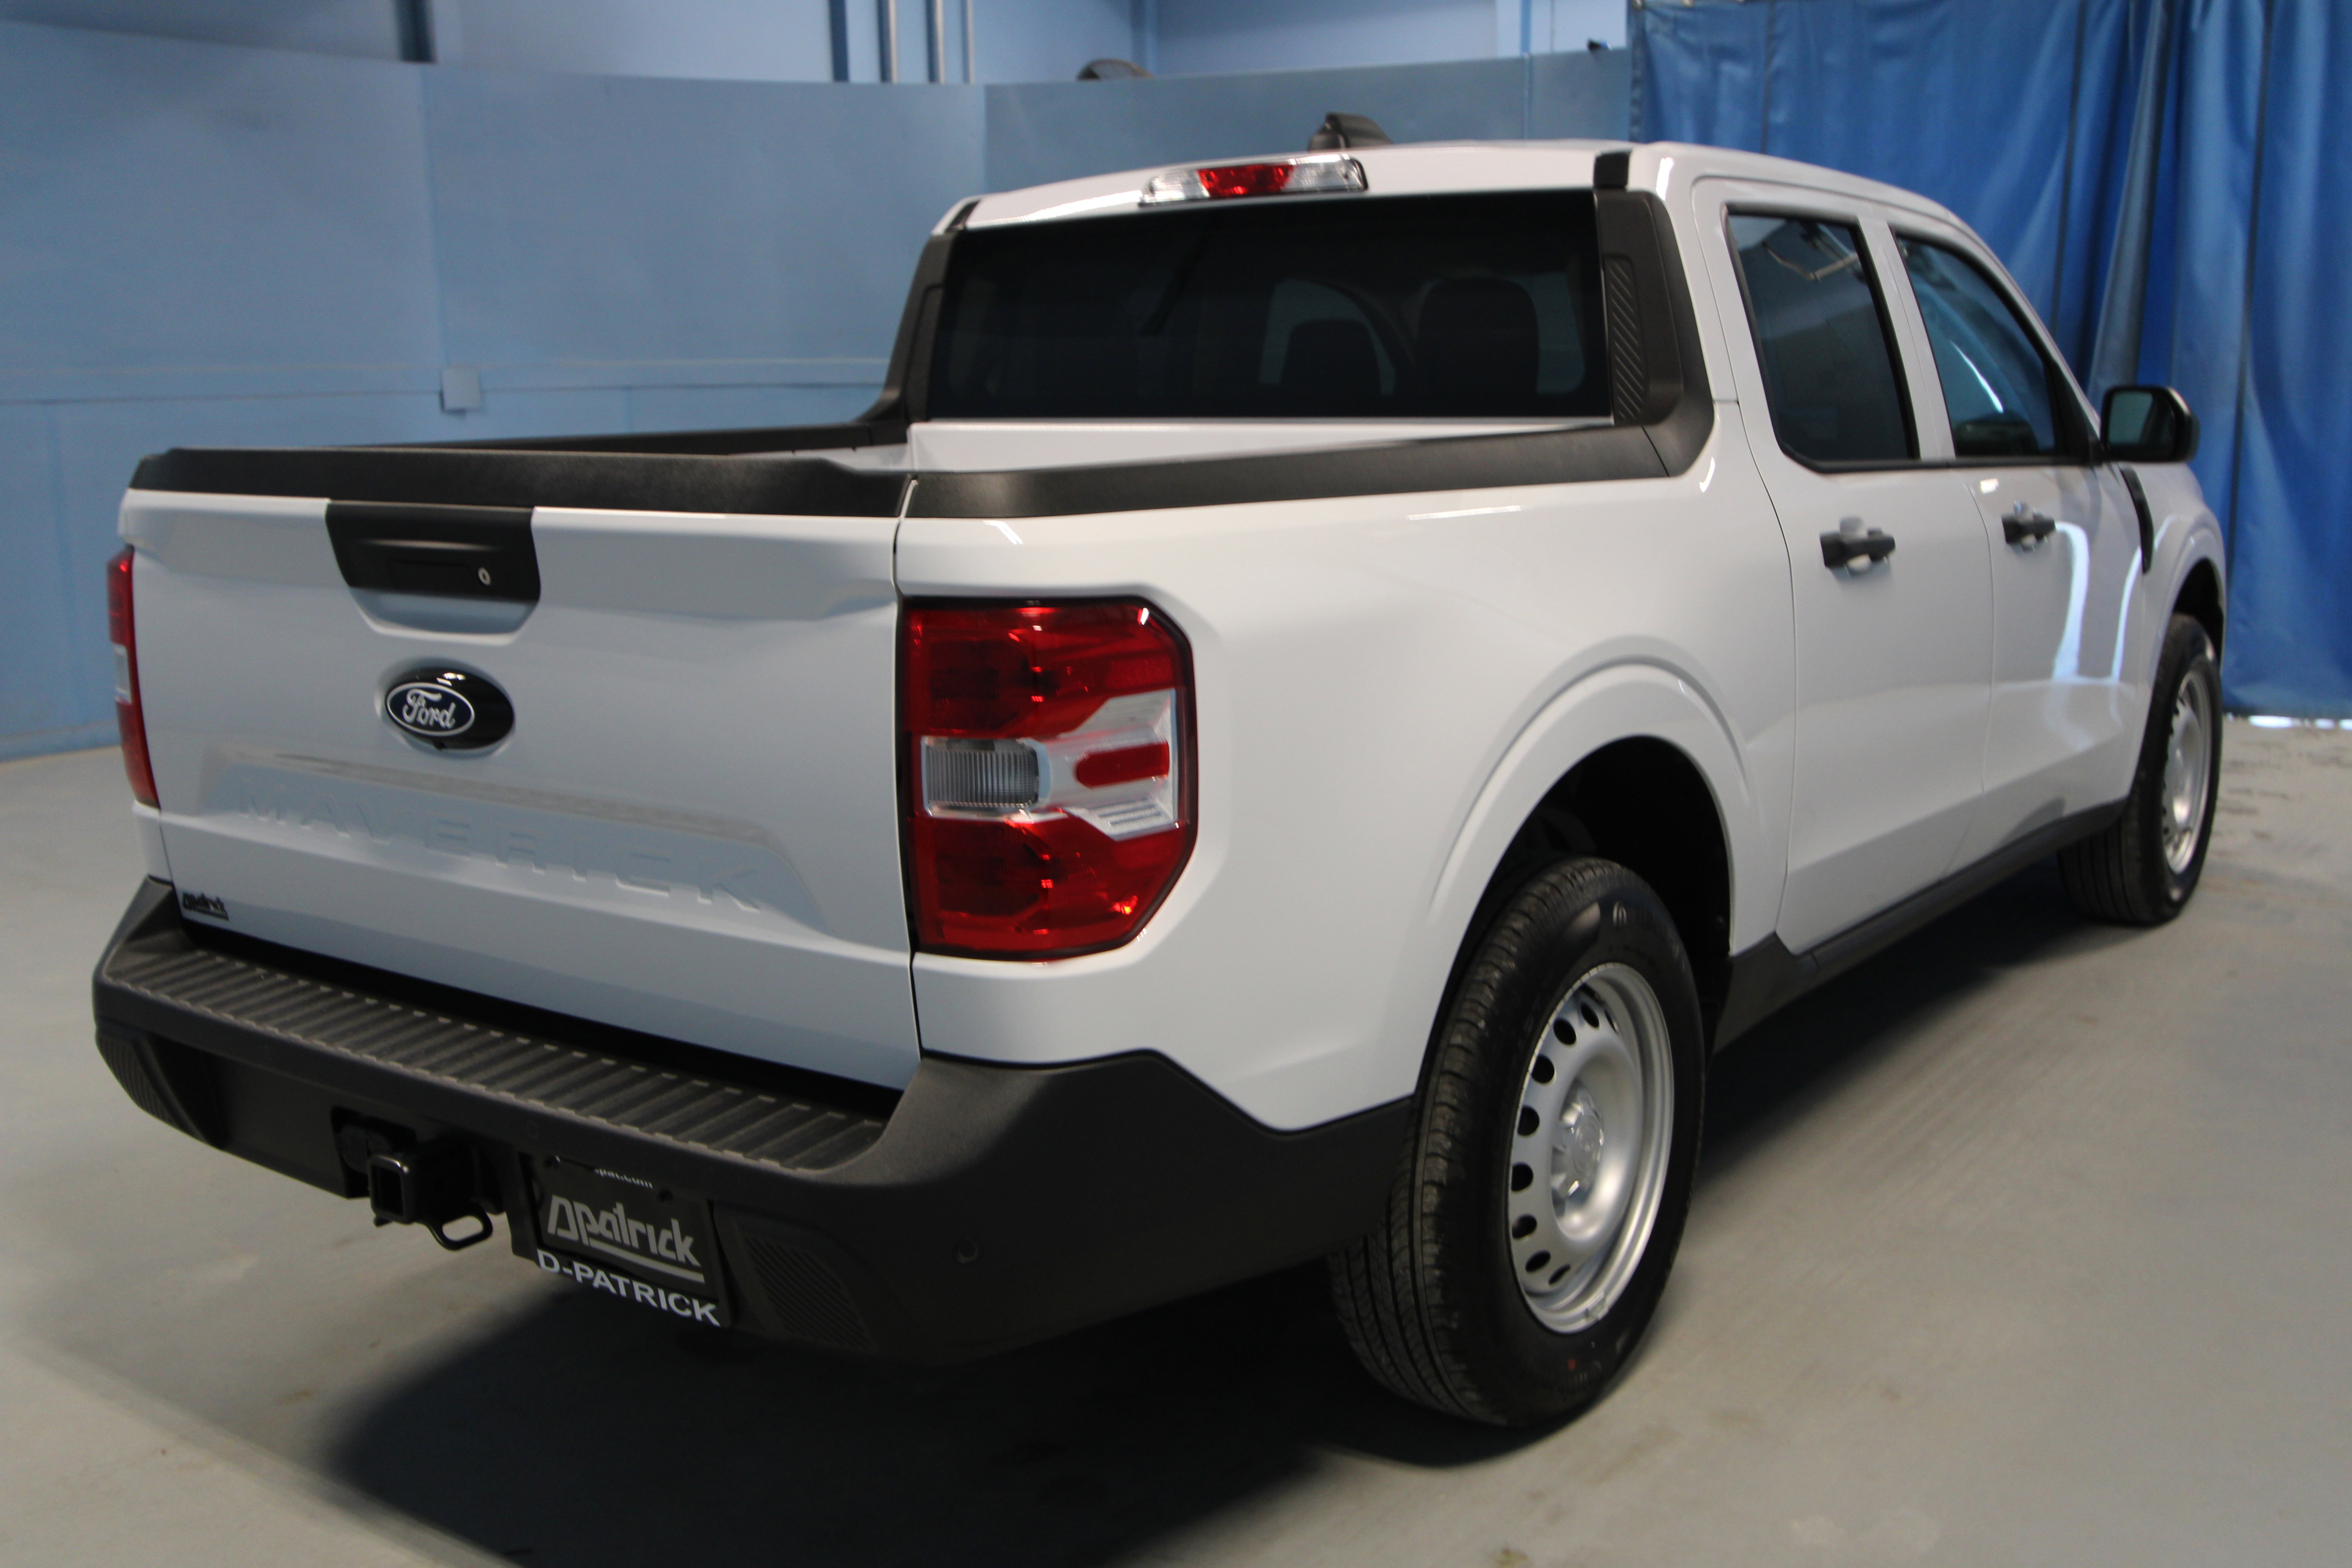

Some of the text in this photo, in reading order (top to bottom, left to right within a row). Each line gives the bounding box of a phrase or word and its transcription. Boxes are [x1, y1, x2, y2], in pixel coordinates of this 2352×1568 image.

[402, 688, 456, 728] Ford
[238, 776, 762, 913] MAVERICK
[537, 1248, 721, 1327] D-PATRICK
